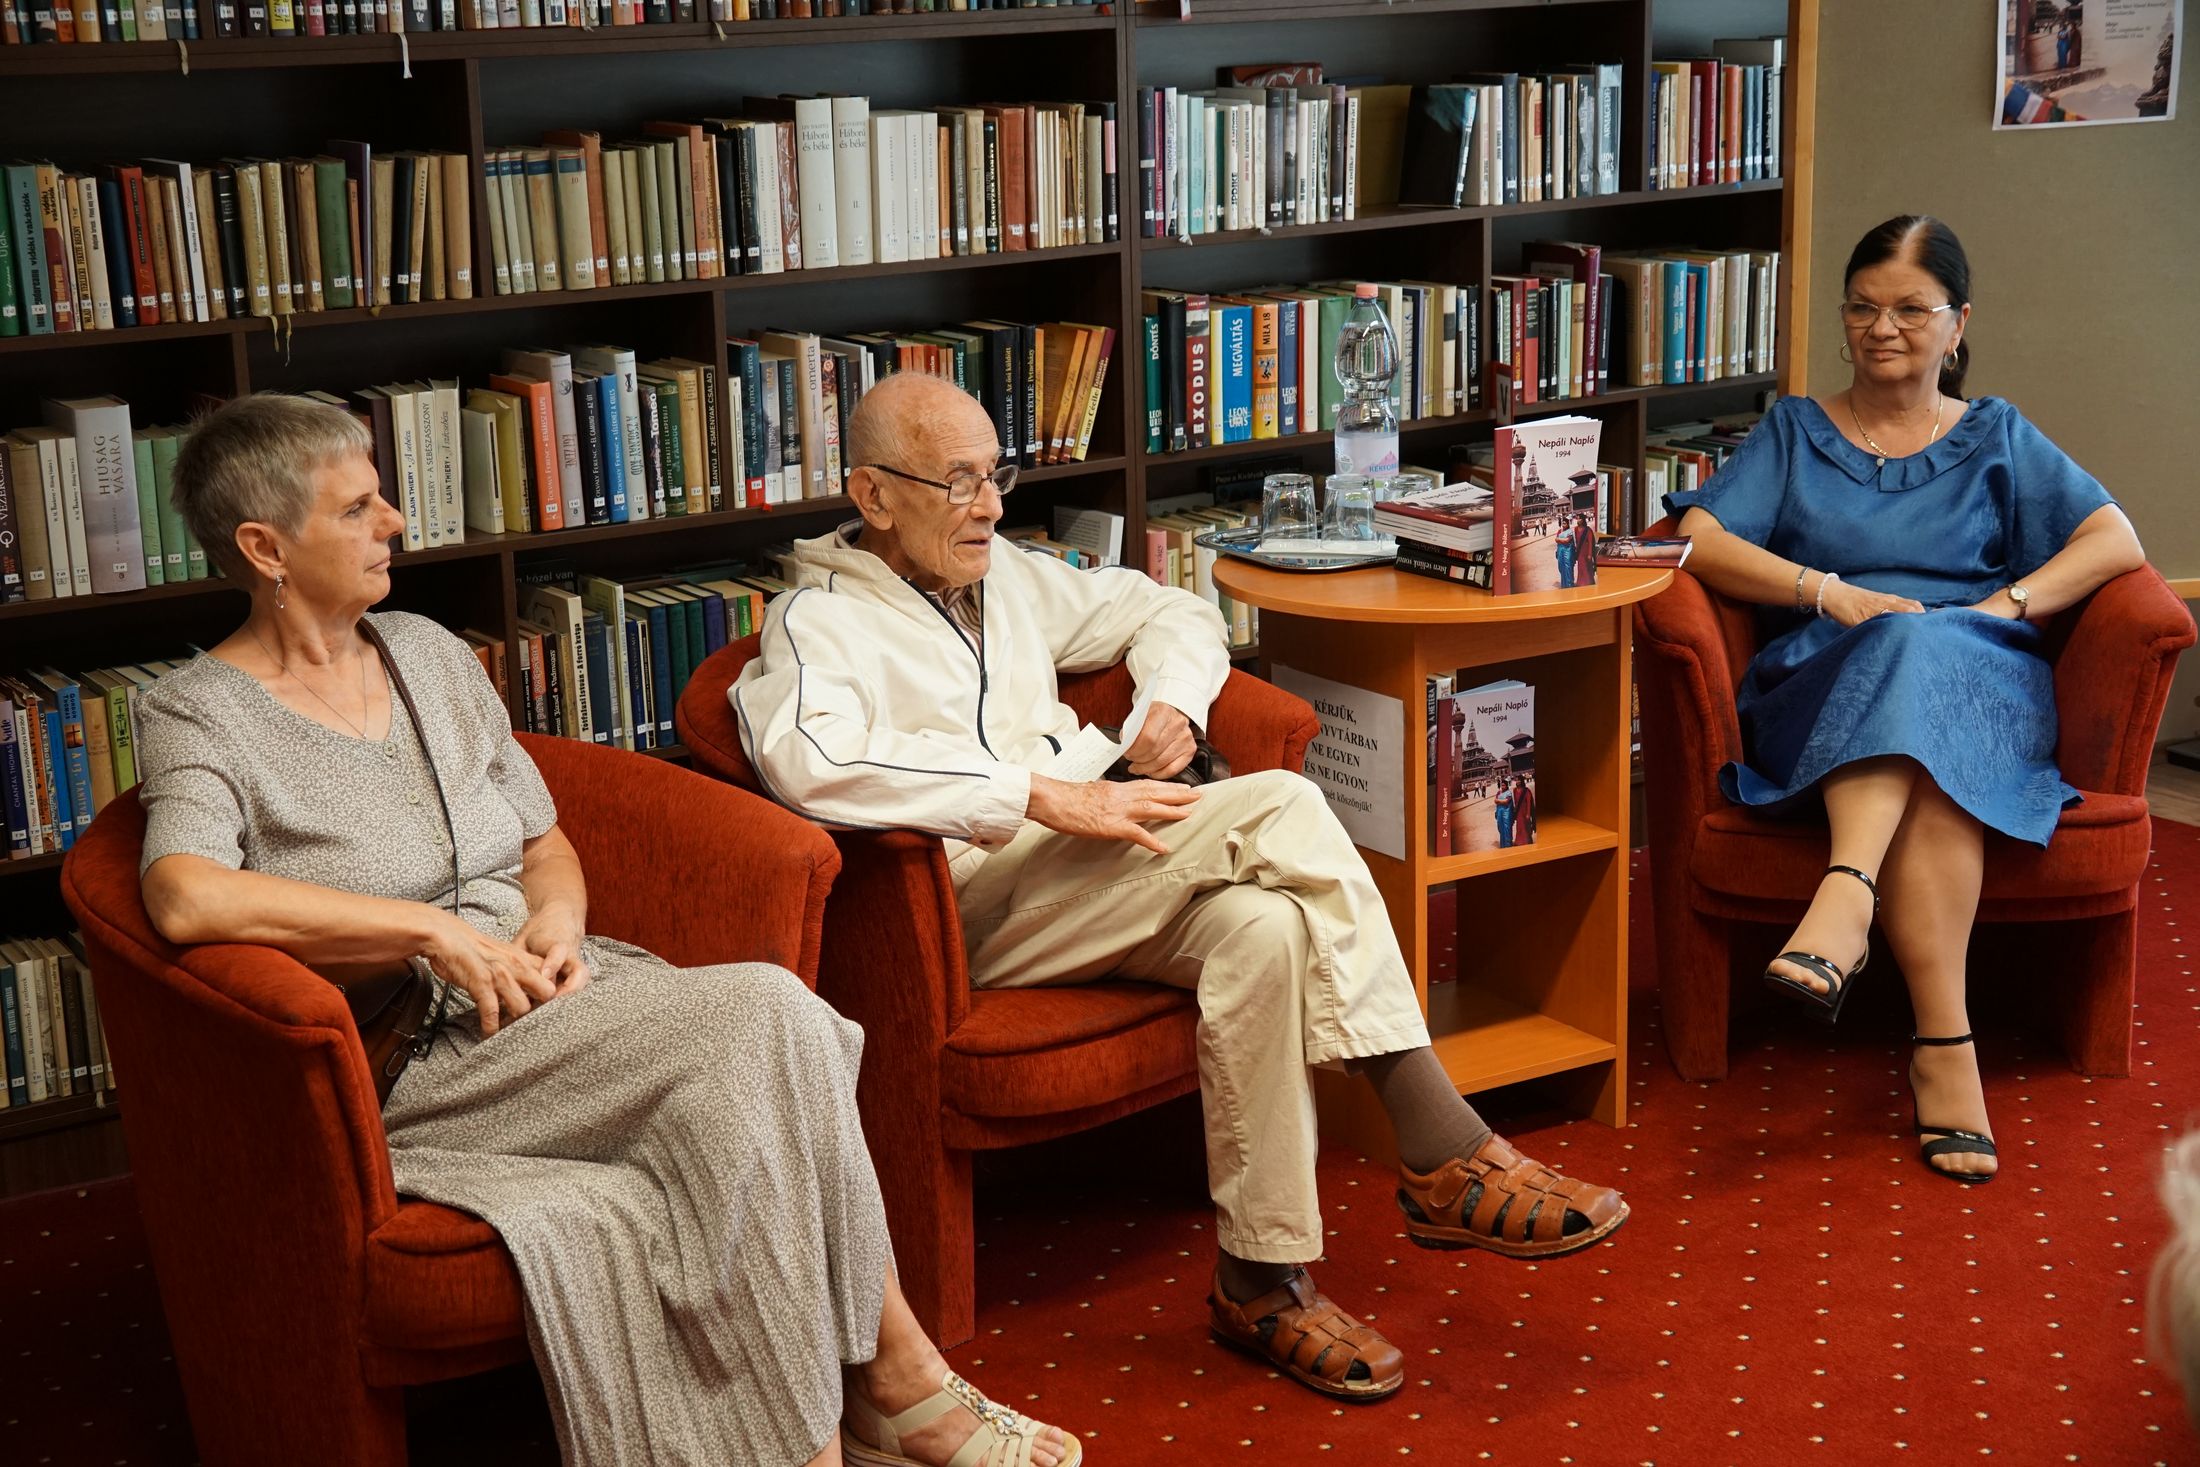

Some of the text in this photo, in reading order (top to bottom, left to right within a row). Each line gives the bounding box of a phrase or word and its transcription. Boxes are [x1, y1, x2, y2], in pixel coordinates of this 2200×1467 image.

[802, 130, 830, 141] Háború
[802, 141, 830, 151] és béke
[839, 129, 866, 139] Háború
[839, 138, 867, 149] és béke
[49, 187, 58, 222] vakációk
[23, 192, 37, 266] vidéki vakációk
[1230, 318, 1243, 377] MEGVÁLTÁS
[807, 345, 817, 391] omerta
[957, 351, 965, 389] gyarország
[1193, 343, 1205, 434] EXODUS
[1282, 387, 1297, 397] LEON
[650, 392, 660, 438] Tomeo
[1149, 409, 1162, 417] LEON
[1229, 406, 1248, 417] LEON
[827, 414, 840, 446] Rizs
[1027, 414, 1035, 444] TORMAY
[1538, 434, 1595, 450] Nepáli Napló
[564, 448, 577, 469] ZENE
[627, 423, 643, 476] ZSOLNAY-KÓD
[1555, 450, 1571, 458] 1994
[93, 435, 110, 496] HIÚSÁG
[109, 434, 124, 494] VÁSÁRA
[555, 570, 574, 580] van
[69, 693, 77, 719] GORDON
[1314, 698, 1357, 725] KÉRJÜK,
[1477, 699, 1529, 716] Nepáli Napló
[1493, 715, 1508, 723] 1994
[1319, 723, 1378, 751] NYVTÁRBAN
[1311, 741, 1360, 767] NE EGYEN
[7, 743, 20, 808] CHANTAL THOMAS
[1304, 758, 1368, 792] ÉS NE IGYON!
[1336, 791, 1372, 813] köszönjük!
